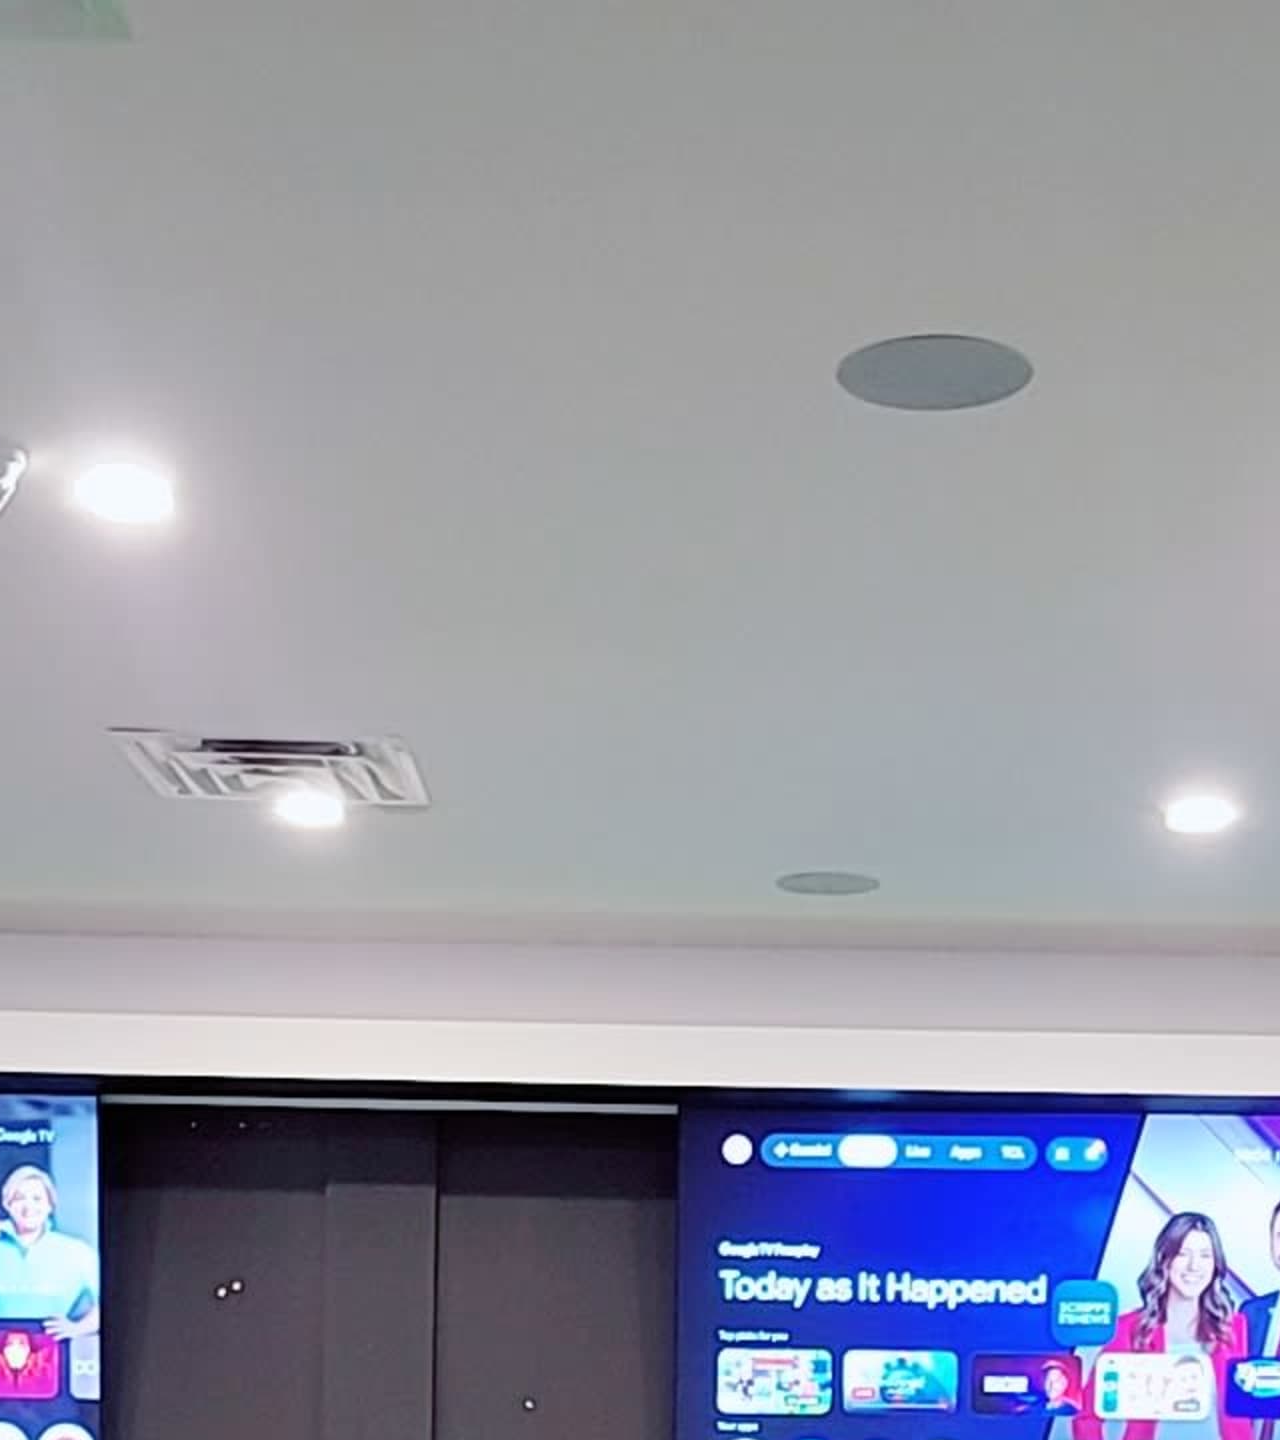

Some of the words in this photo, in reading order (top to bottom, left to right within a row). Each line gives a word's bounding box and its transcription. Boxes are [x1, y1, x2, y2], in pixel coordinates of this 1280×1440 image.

[718, 1269, 812, 1309] Today
[815, 1277, 853, 1303] as
[858, 1271, 880, 1303] It
[886, 1271, 1047, 1311] Happened
